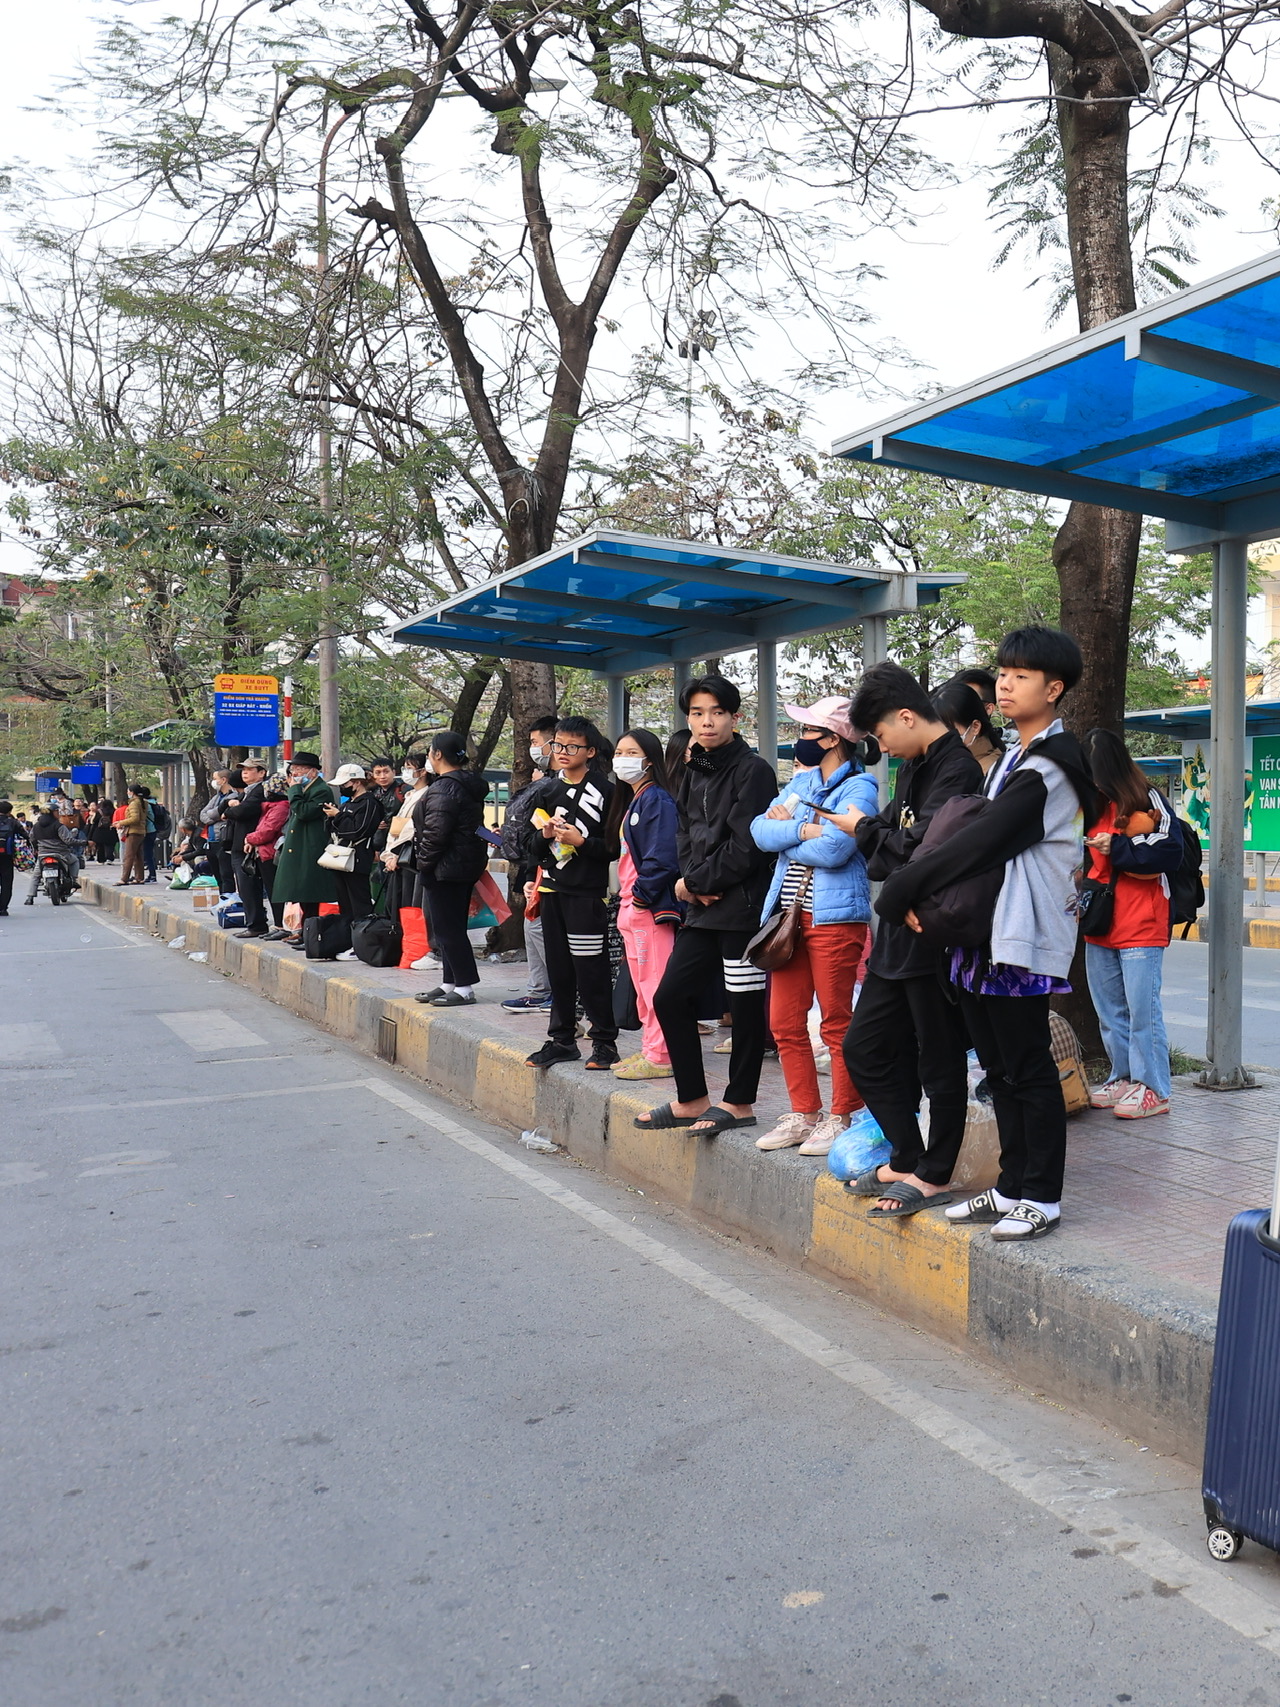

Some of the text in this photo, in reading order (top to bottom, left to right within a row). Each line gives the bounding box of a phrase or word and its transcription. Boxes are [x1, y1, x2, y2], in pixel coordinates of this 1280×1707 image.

[1260, 754, 1275, 771] TẾT
[1259, 778, 1277, 794] VẠN
[1259, 793, 1276, 809] TÂN
